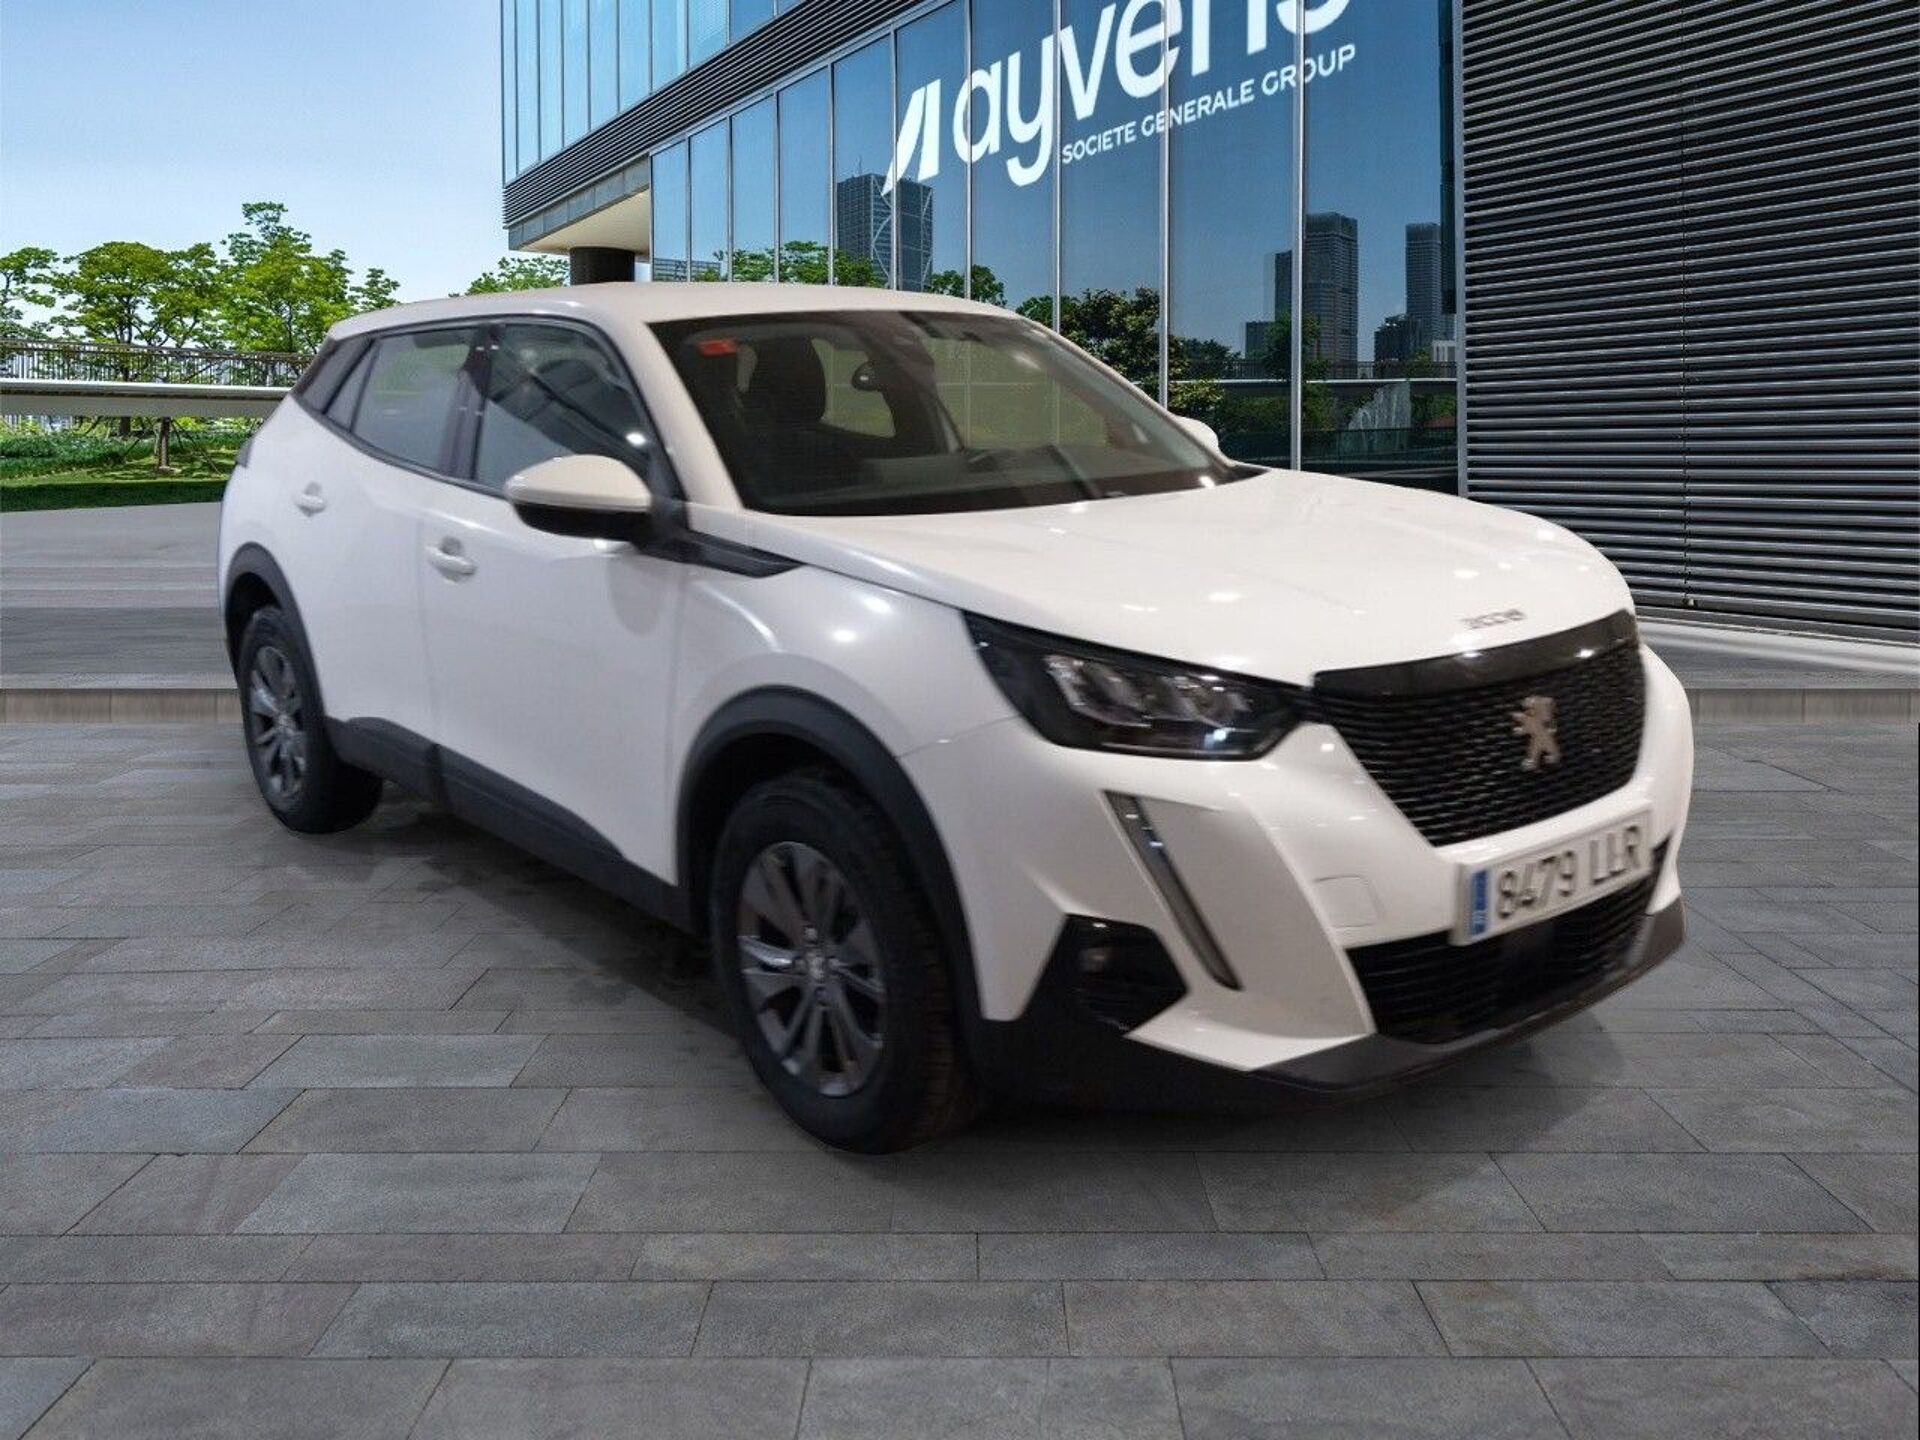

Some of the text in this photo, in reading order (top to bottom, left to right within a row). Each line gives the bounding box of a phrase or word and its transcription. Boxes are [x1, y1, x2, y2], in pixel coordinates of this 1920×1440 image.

[1062, 43, 1357, 164] SOCIETE GENERALE GROUP
[1498, 824, 1642, 919] 8479 LLR
